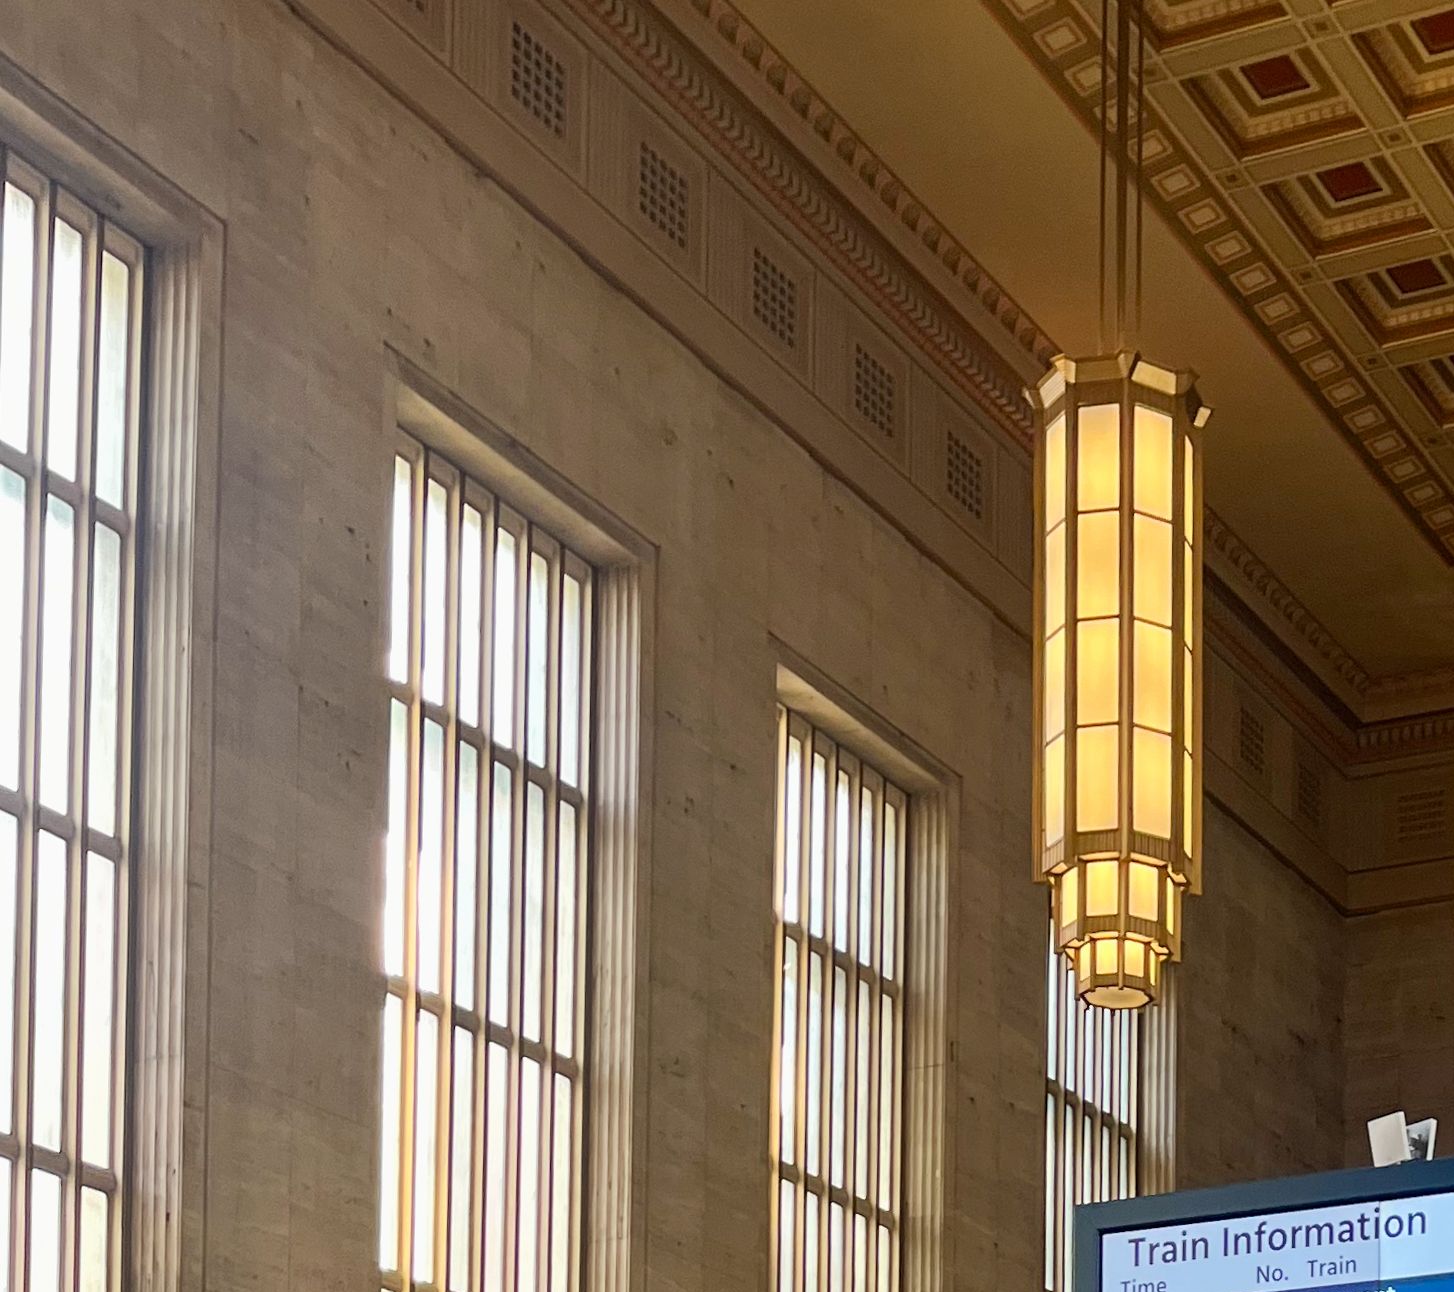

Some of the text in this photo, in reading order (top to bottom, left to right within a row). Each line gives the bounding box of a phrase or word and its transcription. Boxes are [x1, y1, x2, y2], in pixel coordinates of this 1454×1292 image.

[1128, 1207, 1426, 1267] Train Information
[1256, 1265, 1289, 1284] No.
[1307, 1255, 1357, 1278] Train
